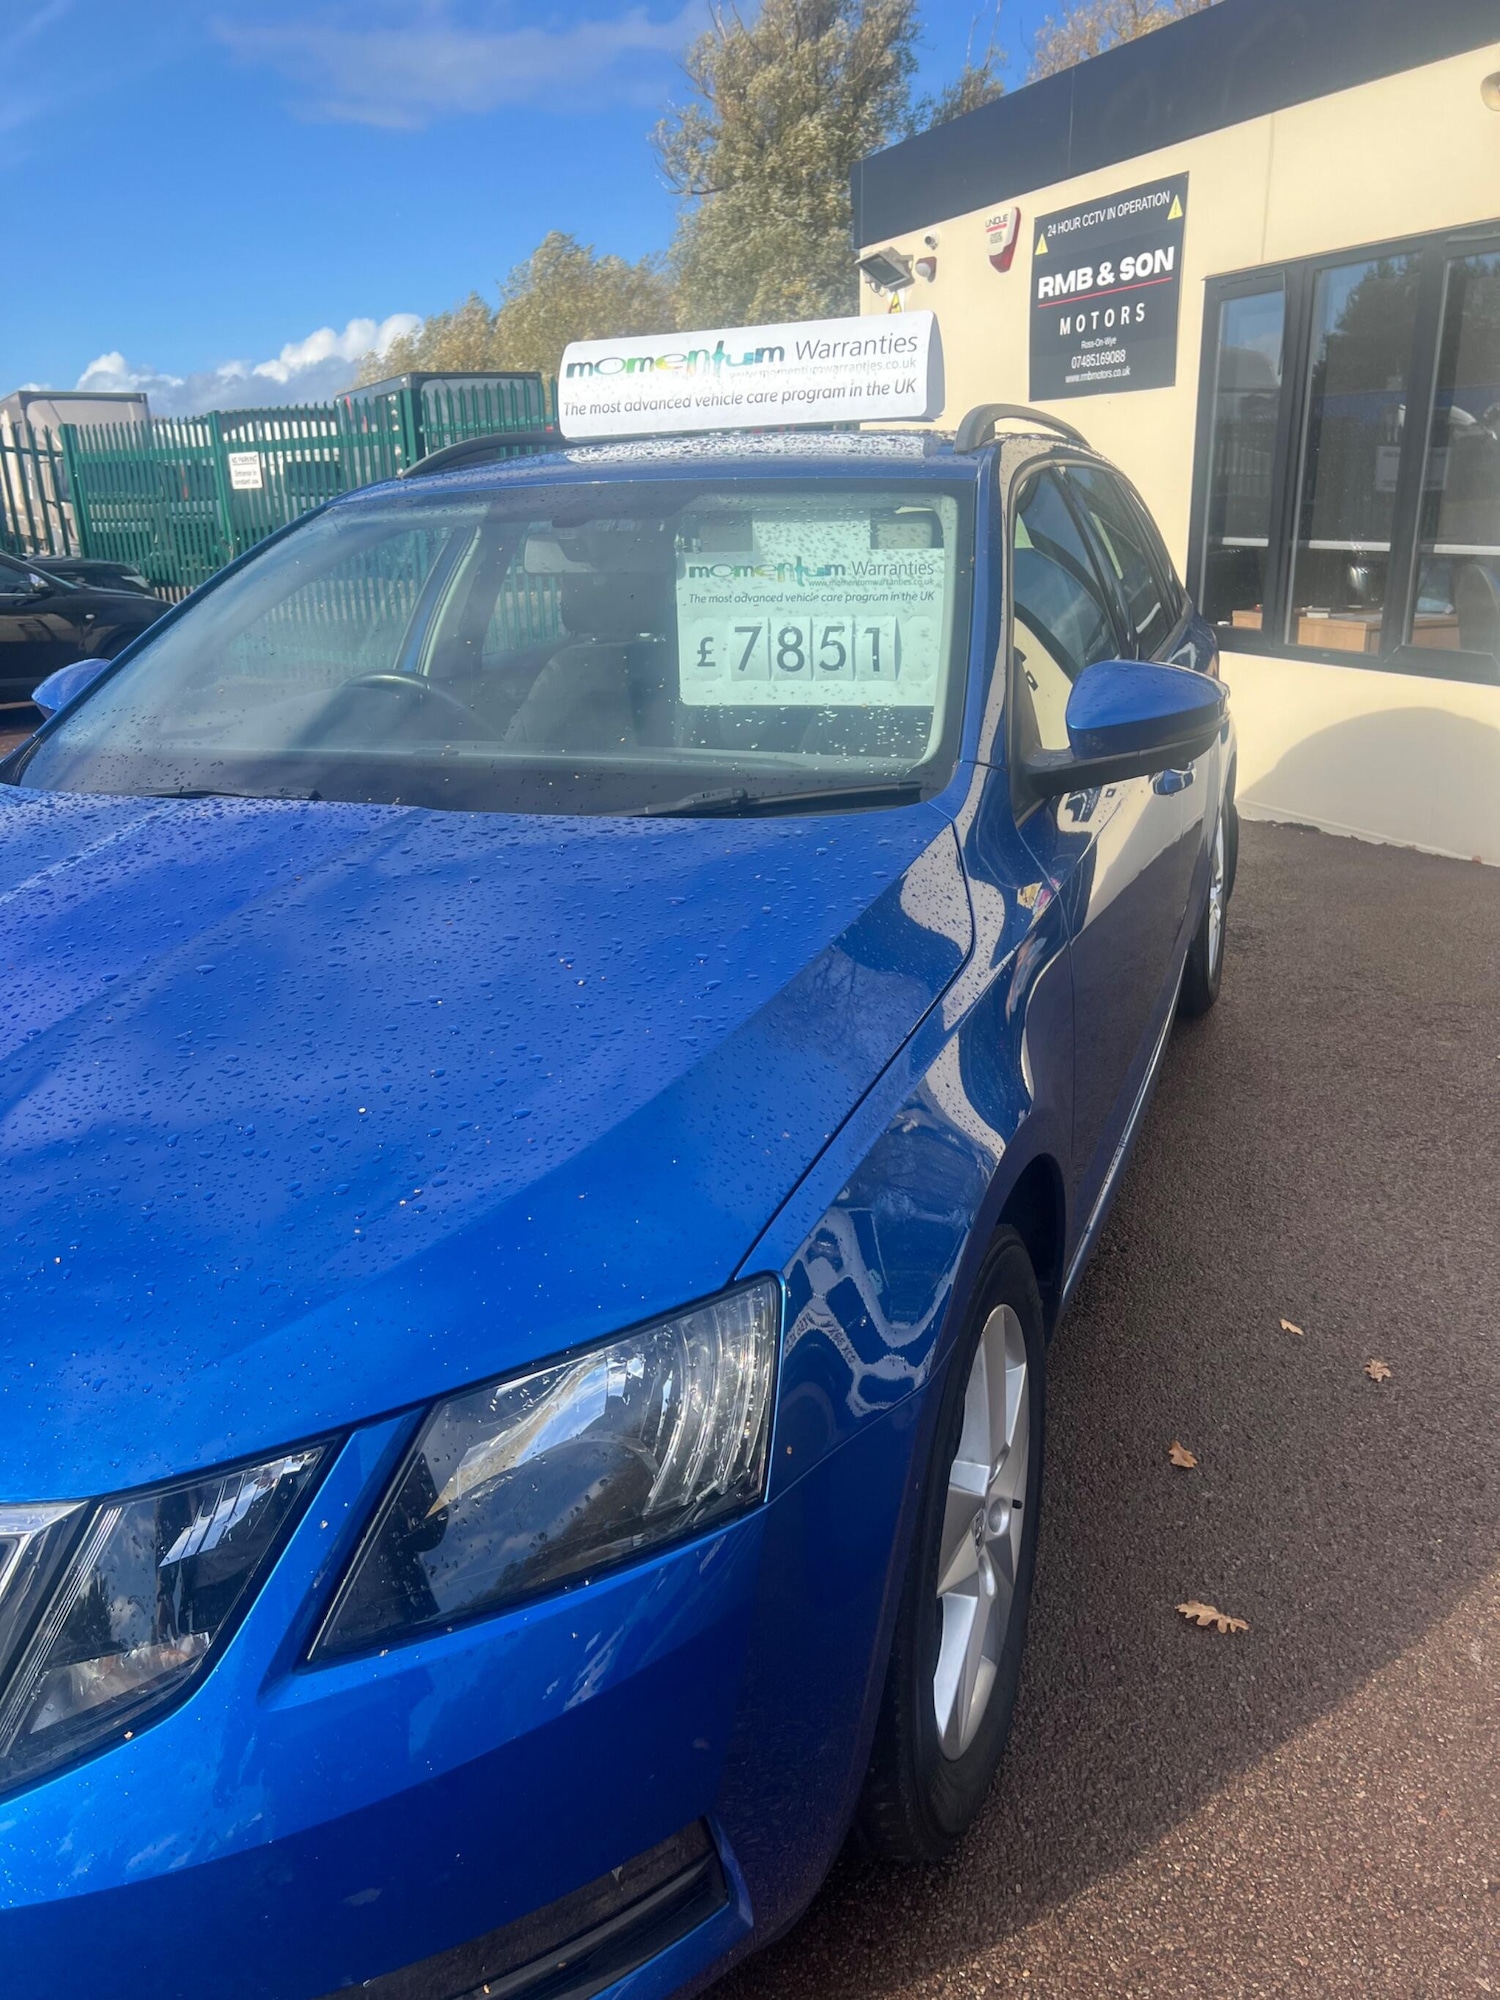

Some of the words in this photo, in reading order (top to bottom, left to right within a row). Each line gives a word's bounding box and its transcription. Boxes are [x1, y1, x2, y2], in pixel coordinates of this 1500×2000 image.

[1047, 224, 1057, 237] 24
[1057, 216, 1081, 234] HOUR
[1082, 209, 1106, 227] CCTV
[1106, 206, 1116, 220] IN
[1117, 190, 1171, 217] OPERATION
[1037, 266, 1093, 299] RMB
[1096, 261, 1115, 286] &
[1119, 246, 1174, 281] SON
[1060, 302, 1145, 336] MOTORS
[566, 340, 785, 378] momentum
[795, 332, 918, 361] Warranties
[1071, 349, 1126, 369] 07485169088
[563, 401, 587, 416] The
[590, 401, 621, 414] most
[624, 395, 692, 412] advanced
[695, 391, 743, 408] vehicle
[746, 391, 778, 404] care
[782, 386, 846, 405] program
[850, 382, 863, 397] in
[867, 381, 891, 396] the
[894, 377, 917, 394] UK
[689, 556, 846, 587] momentum
[851, 559, 934, 576] Warranties
[689, 593, 706, 603] The
[708, 593, 732, 603] most
[734, 592, 783, 603] advanced
[785, 592, 819, 602] vehicle
[820, 593, 843, 602] care
[845, 593, 888, 604] program
[890, 591, 900, 601] in
[901, 591, 918, 601] the
[920, 590, 935, 601] UK
